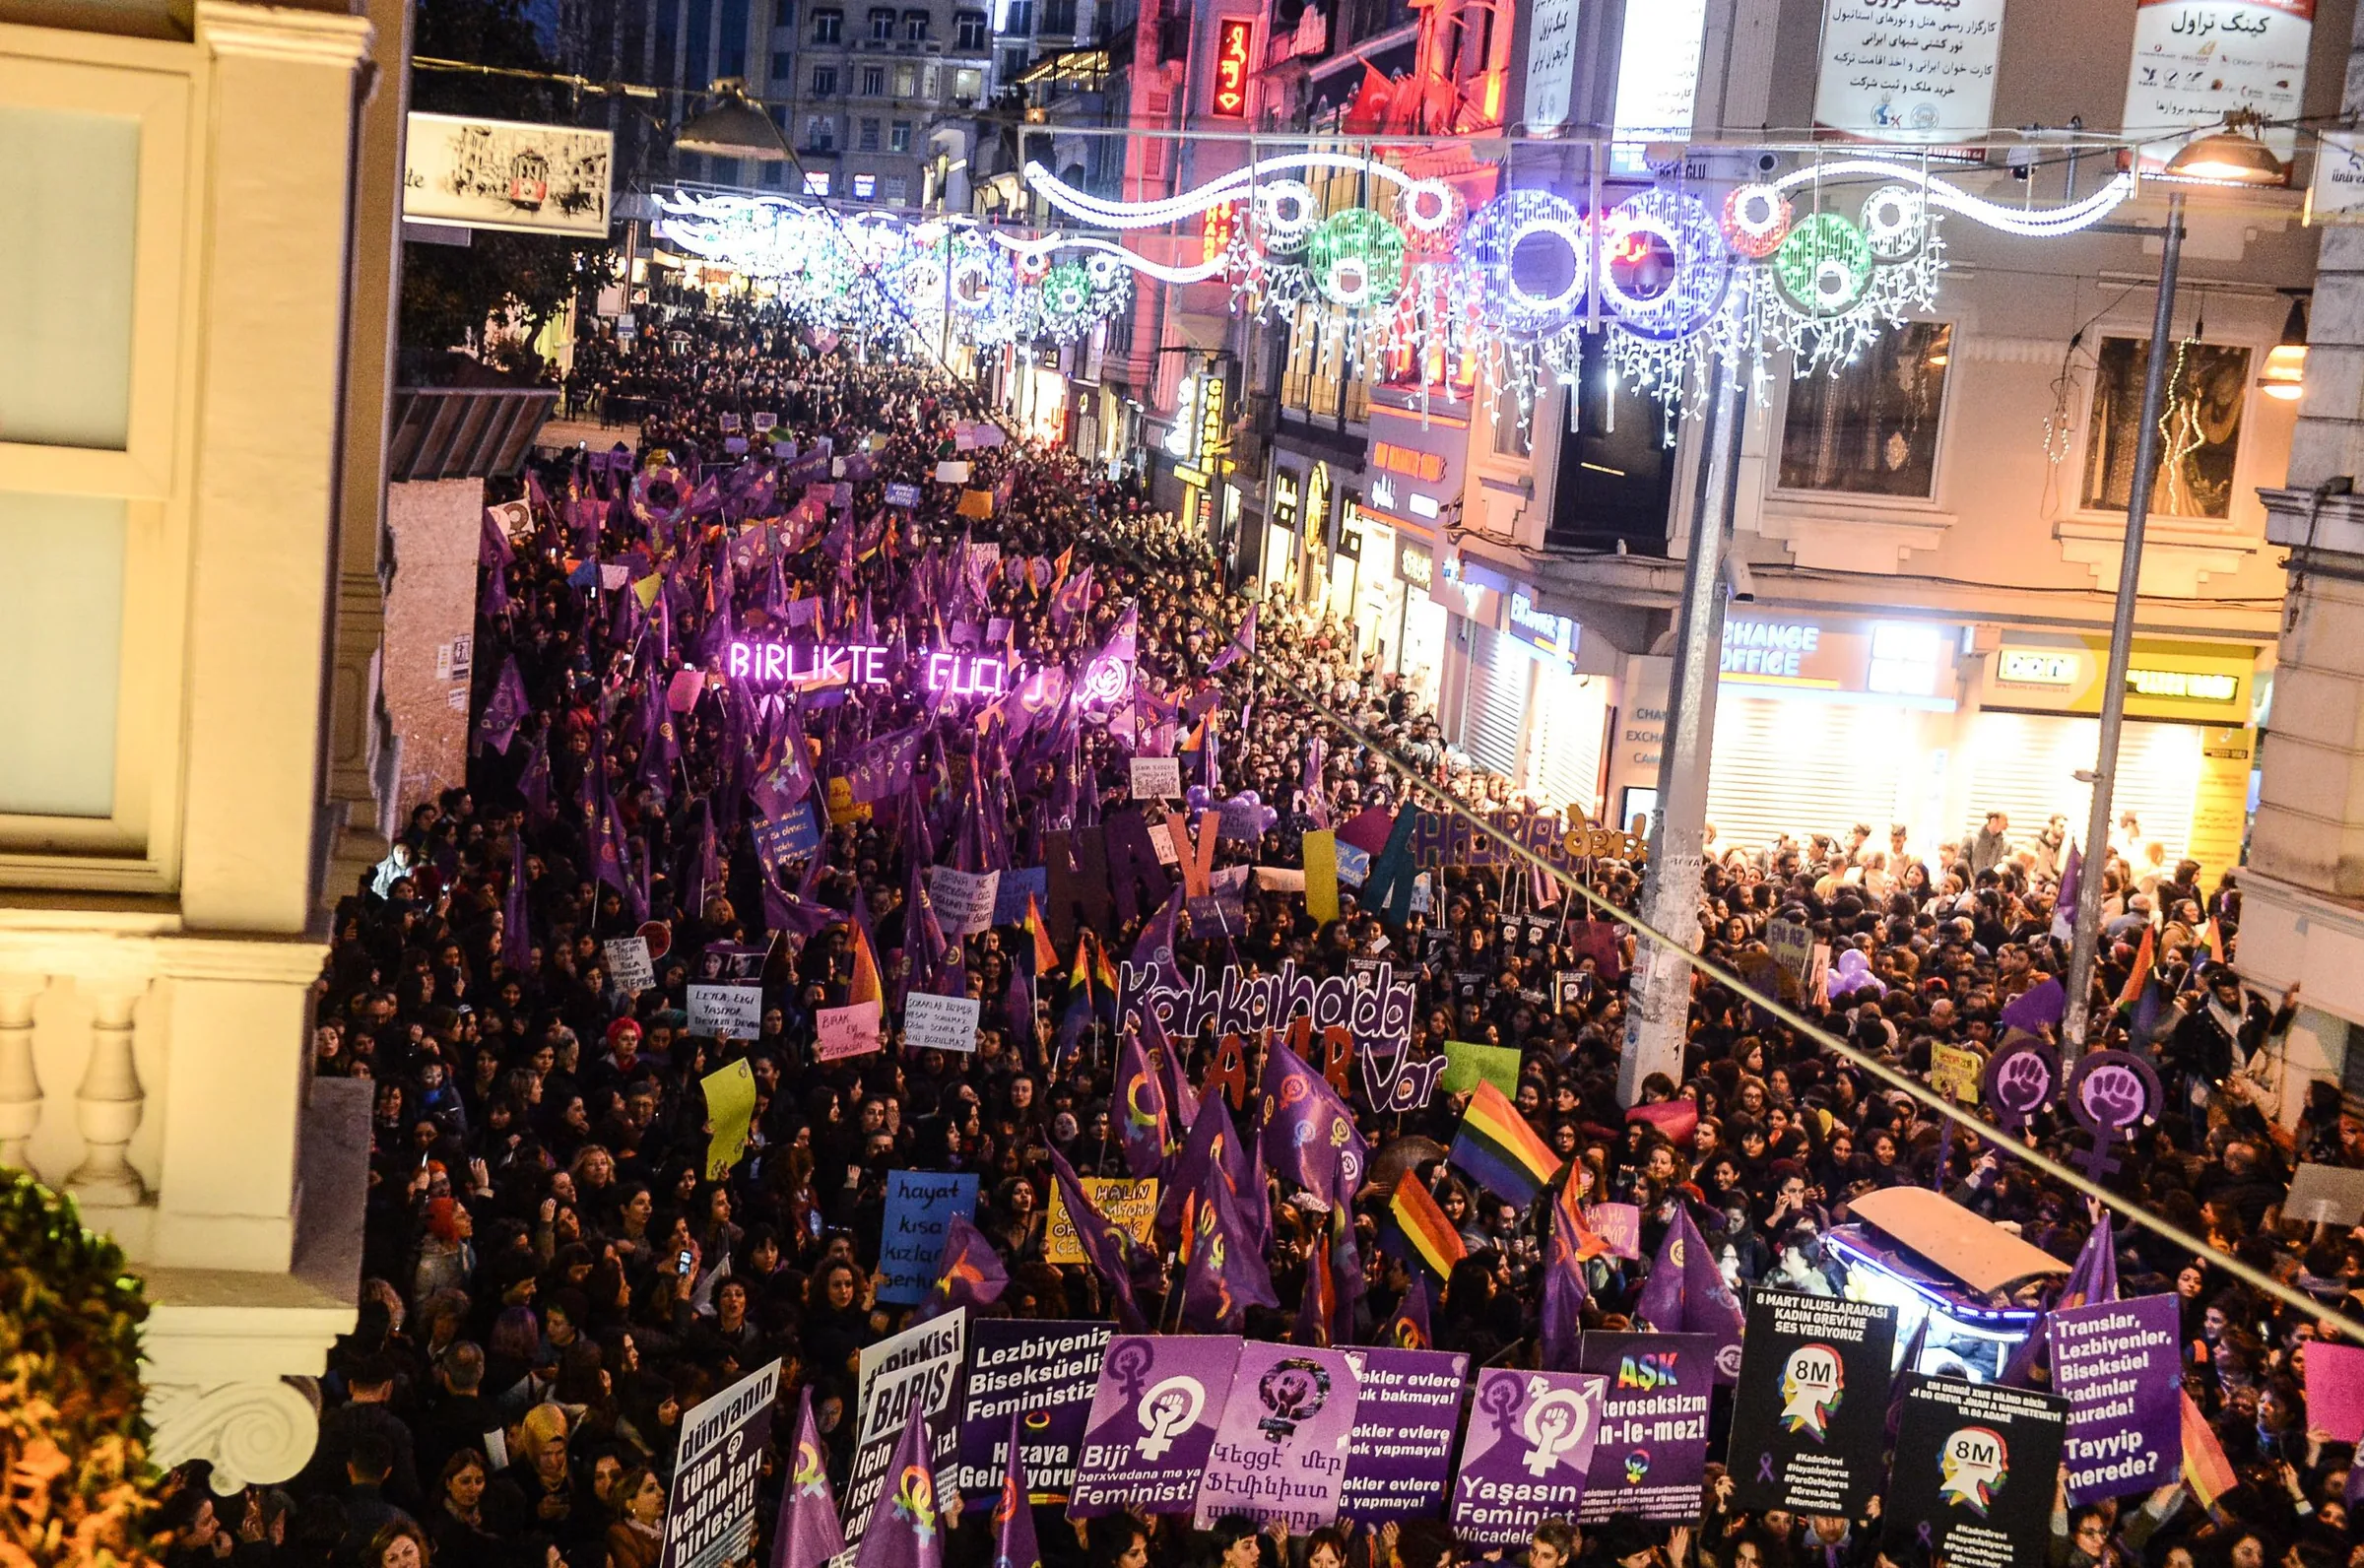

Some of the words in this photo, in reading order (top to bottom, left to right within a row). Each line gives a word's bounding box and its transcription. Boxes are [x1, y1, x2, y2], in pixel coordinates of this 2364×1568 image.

[2171, 10, 2215, 36] تراول
[2221, 12, 2269, 38] کینگ
[1942, 62, 1967, 76] خوان
[1970, 64, 1993, 78] کارت
[1910, 81, 1931, 93] ملک
[1201, 378, 1223, 475] CHANGE
[1363, 1037, 1449, 1113] Var
[898, 1179, 959, 1209] hayat
[1756, 1293, 1764, 1305] 8
[1766, 1293, 1800, 1307] MART
[1801, 1297, 1888, 1319] ULUSLARARASI
[1775, 1307, 1812, 1323] KADIN
[1775, 1321, 1799, 1335] SES
[1799, 1323, 1864, 1342] VERİYORUZ
[2056, 1313, 2141, 1338] Translar,
[976, 1327, 1111, 1367] Lezbiyeniz
[2059, 1330, 2172, 1360] Lezbiyenler,
[969, 1352, 1103, 1396] Biseksüeli
[1361, 1370, 1404, 1385] ekler
[1408, 1373, 1460, 1389] evlere
[1617, 1352, 1677, 1392] AŞK
[1796, 1360, 1831, 1383] 8M
[2061, 1351, 2149, 1382] Biseksüel
[1380, 1388, 1455, 1405] bakmaya!
[1927, 1381, 1940, 1391] EM
[2062, 1378, 2137, 1404] kadınlar
[966, 1381, 1098, 1422] Feministiz
[1603, 1394, 1707, 1418] teroseksizm
[1990, 1402, 1998, 1410] A
[682, 1372, 773, 1466] dünyanın
[1351, 1423, 1395, 1438] ekler
[1399, 1425, 1450, 1441] evlere
[1595, 1415, 1705, 1445] n-le-mez!
[993, 1442, 1070, 1465] Hzaya
[1084, 1445, 1132, 1470] Bijî
[1374, 1443, 1446, 1458] yapmaya!
[1955, 1440, 1995, 1464] 8M
[2064, 1429, 2142, 1460] Tayyip
[858, 1442, 891, 1478] için
[2068, 1452, 2158, 1489] nerede?
[682, 1452, 722, 1503] tüm
[1078, 1469, 1158, 1483] berxwedana
[1162, 1468, 1182, 1478] me
[1186, 1469, 1201, 1479] ya
[1343, 1476, 1385, 1491] ekler
[1389, 1477, 1440, 1492] evlere
[670, 1447, 763, 1544] kadınları
[851, 1474, 886, 1511] ısra
[1074, 1480, 1197, 1506] Feminîst!
[1353, 1495, 1425, 1510] yapmaya!
[1462, 1475, 1576, 1506] Yaşasın
[675, 1478, 755, 1568] birleşti!
